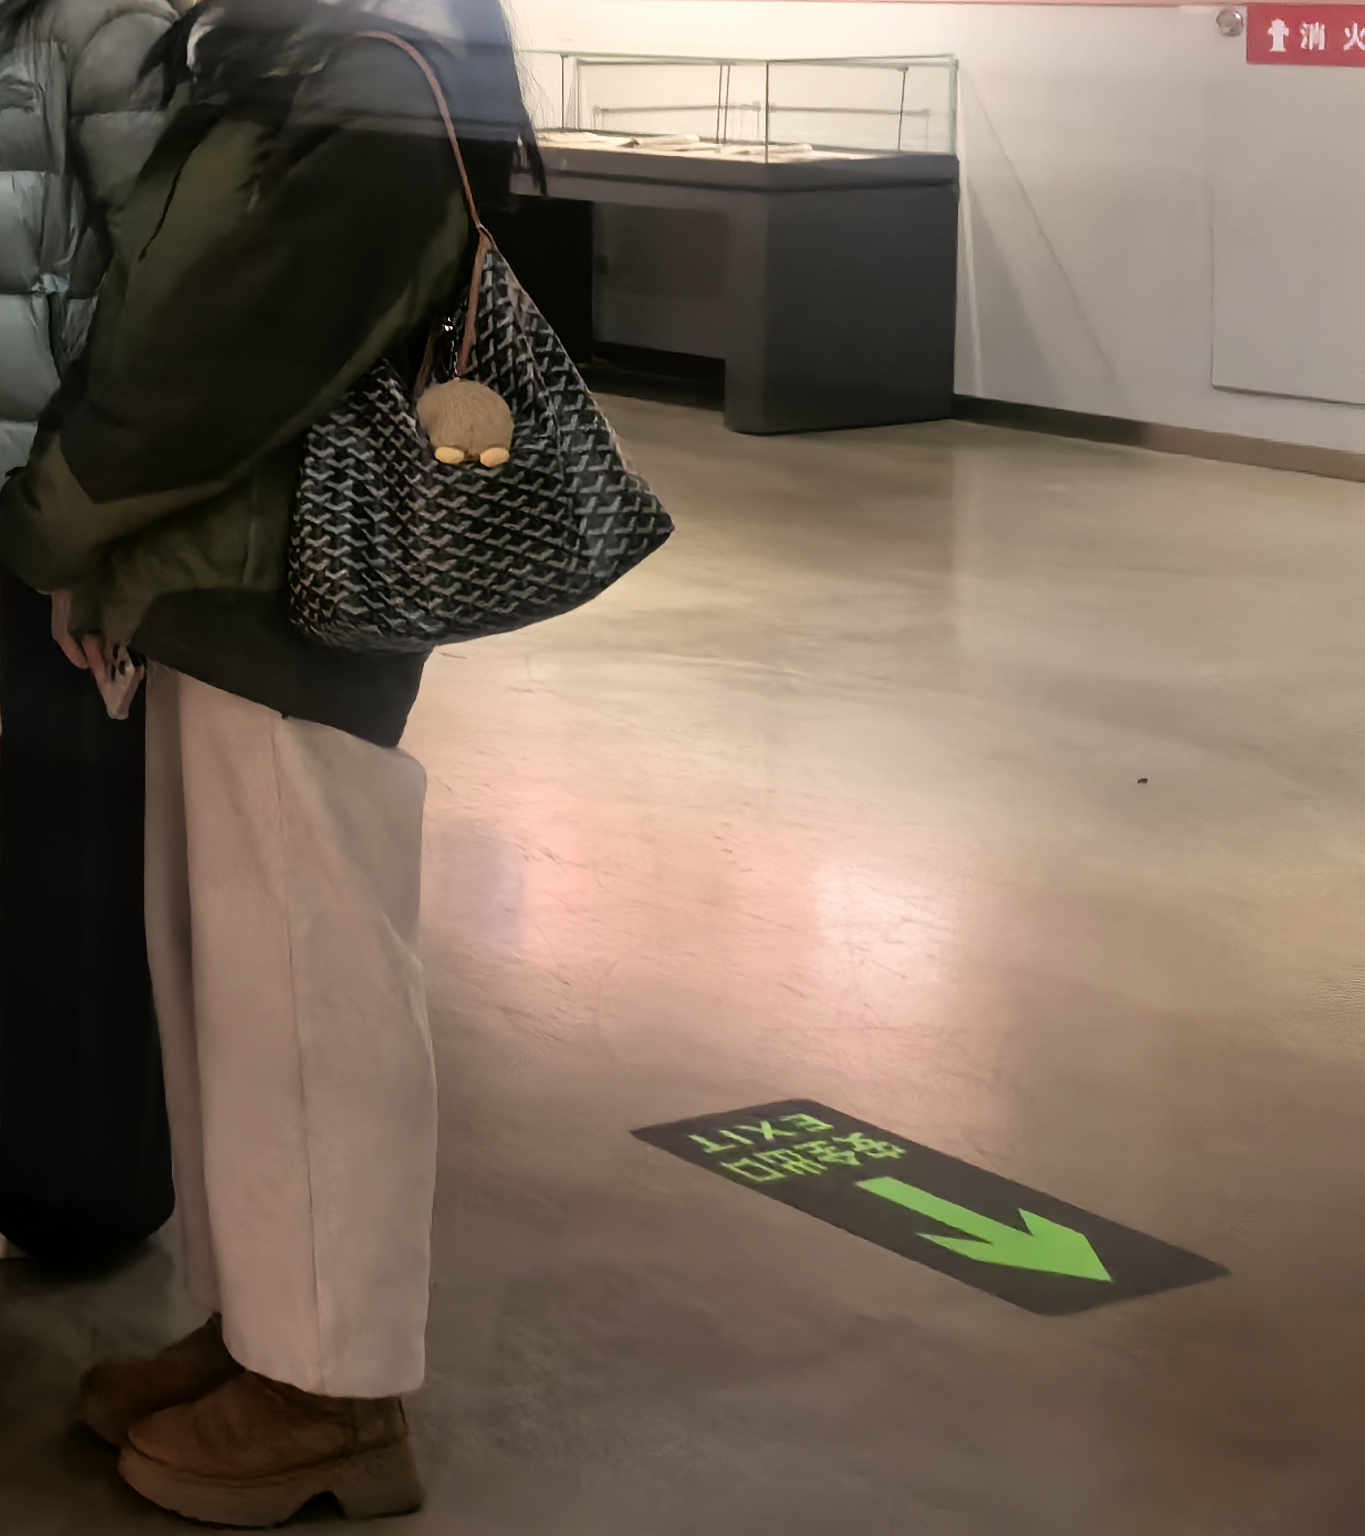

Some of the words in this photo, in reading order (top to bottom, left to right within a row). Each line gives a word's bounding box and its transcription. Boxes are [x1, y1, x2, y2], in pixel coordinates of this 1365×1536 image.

[1299, 20, 1365, 51] 消火
[688, 1113, 835, 1154] EXIT
[719, 1132, 907, 1182] 安全出口
